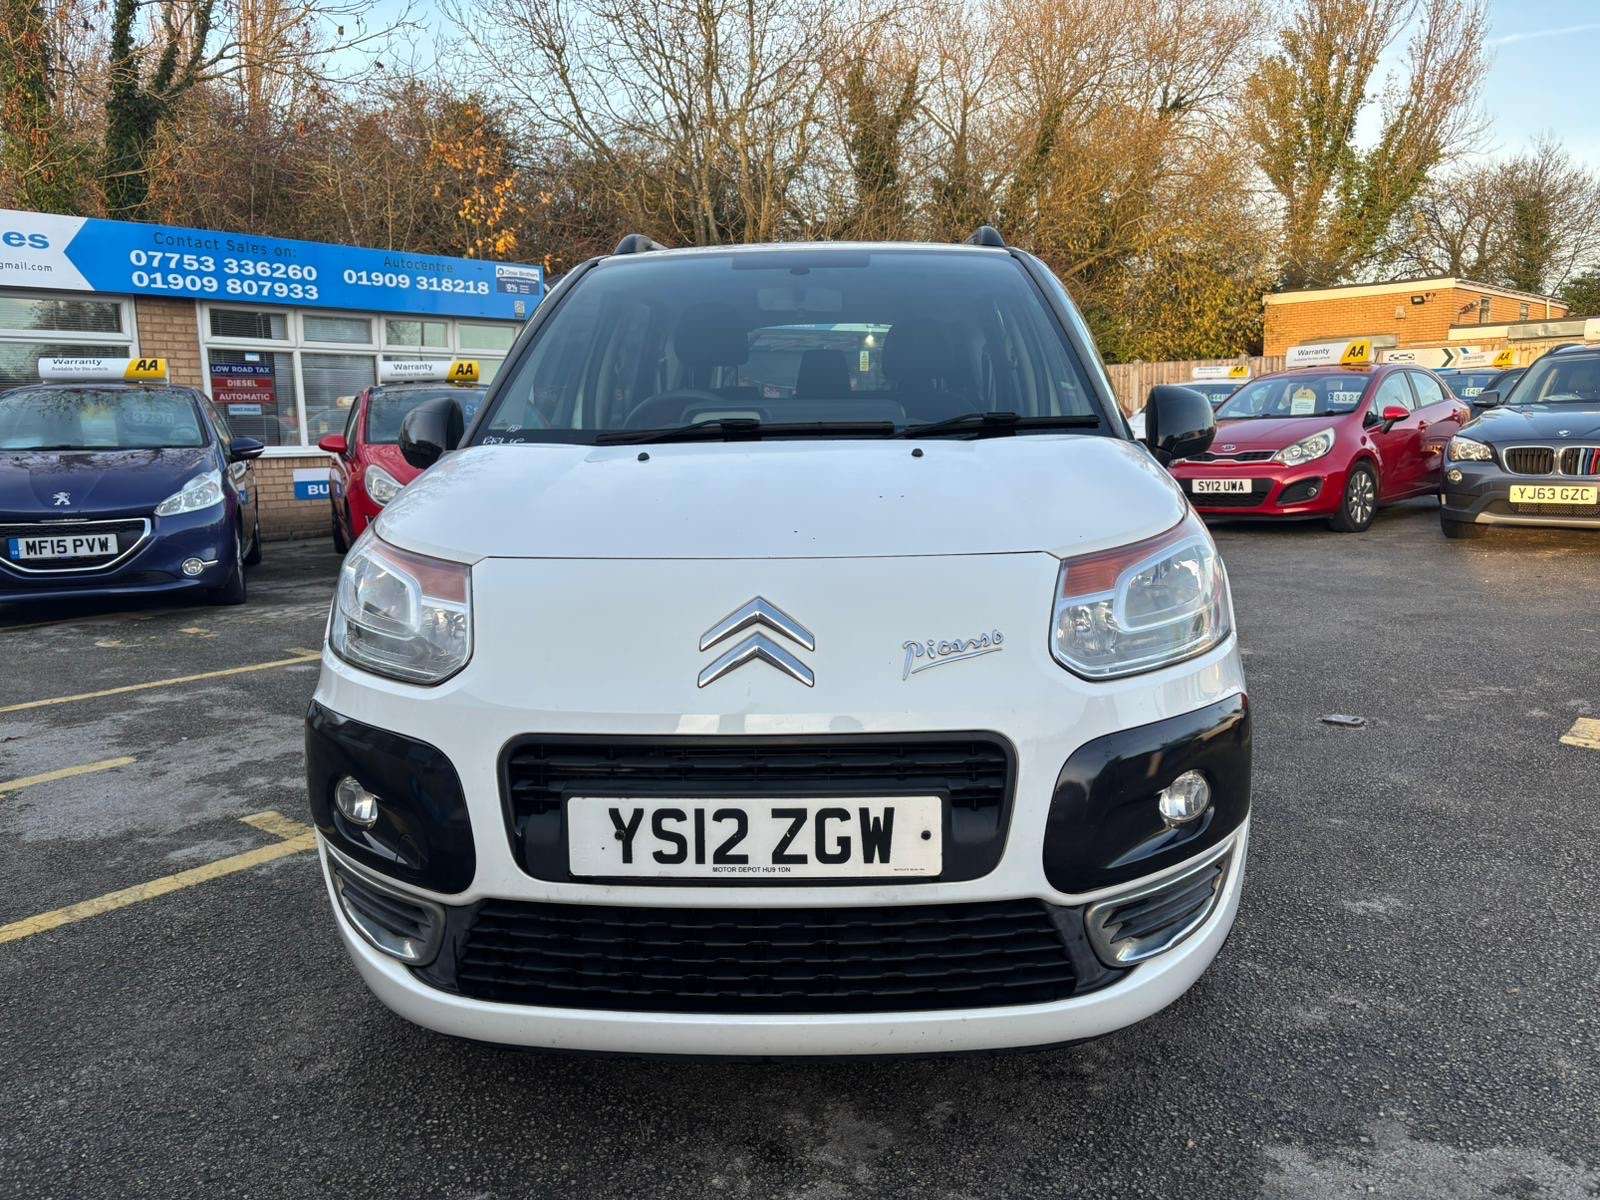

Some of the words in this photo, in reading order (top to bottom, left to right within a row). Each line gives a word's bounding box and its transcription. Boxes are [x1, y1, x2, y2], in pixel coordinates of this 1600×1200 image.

[153, 231, 220, 252] Contact
[226, 239, 267, 257] Sales
[273, 247, 297, 259] on:
[129, 249, 216, 272] 07753
[223, 257, 318, 282] 336260
[383, 255, 454, 274] Autocentre
[131, 270, 219, 293] 01909
[225, 278, 320, 301] 807933
[343, 268, 411, 289] 01909
[415, 275, 490, 296] 318218
[1297, 348, 1330, 357] Warranty
[1348, 345, 1365, 358] AA
[52, 359, 102, 368] Warranty
[135, 359, 158, 371] AA
[211, 365, 230, 373] LOW
[254, 366, 270, 374] TAX
[393, 363, 433, 372] Warranty
[456, 363, 474, 376] AA
[227, 379, 258, 388] DIESEL
[219, 393, 270, 402] AUTOMATIC
[1198, 480, 1221, 492] SY12
[1223, 480, 1245, 492] UWA
[1518, 487, 1556, 501] YJ63
[1560, 488, 1590, 502] GZC
[25, 539, 67, 556] MF15
[72, 537, 109, 555] PVW
[903, 629, 1004, 681] Picasso
[608, 808, 749, 865] YS12
[771, 807, 895, 865] ZGW
